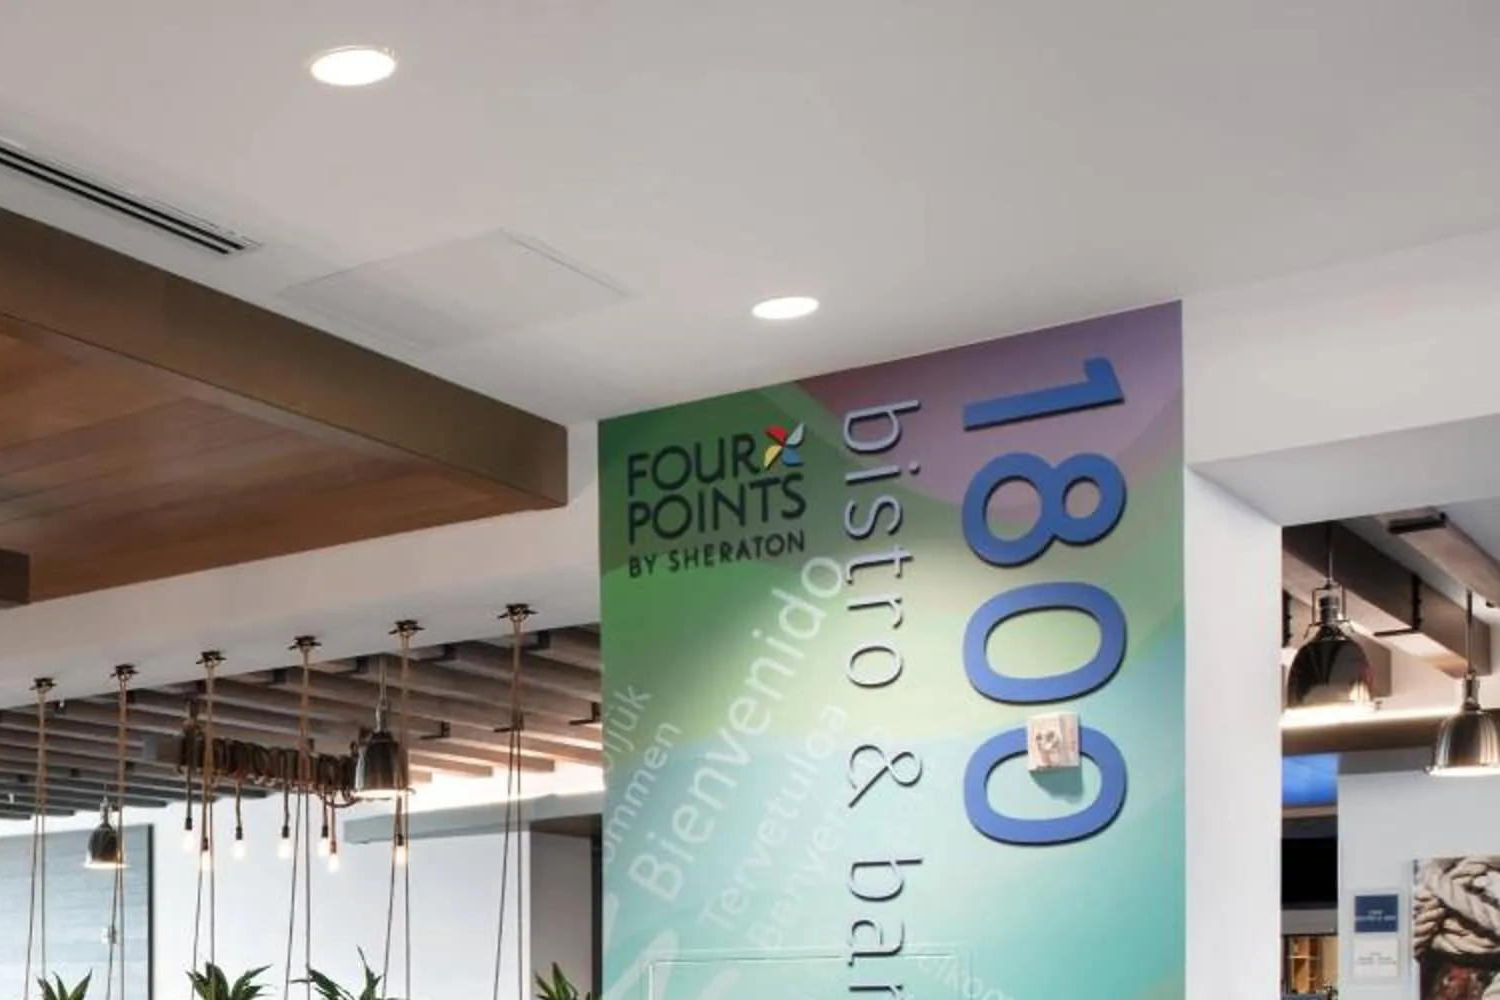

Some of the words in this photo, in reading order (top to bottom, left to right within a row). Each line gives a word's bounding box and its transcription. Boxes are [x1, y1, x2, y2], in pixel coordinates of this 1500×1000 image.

[627, 431, 762, 497] FOUR
[627, 471, 808, 545] POINTS
[842, 400, 922, 690] bistro
[627, 551, 658, 578] BY
[668, 528, 807, 573] SHERATON
[962, 356, 1129, 848] 1800
[627, 555, 844, 901] Bienvenido
[845, 743, 924, 809] &
